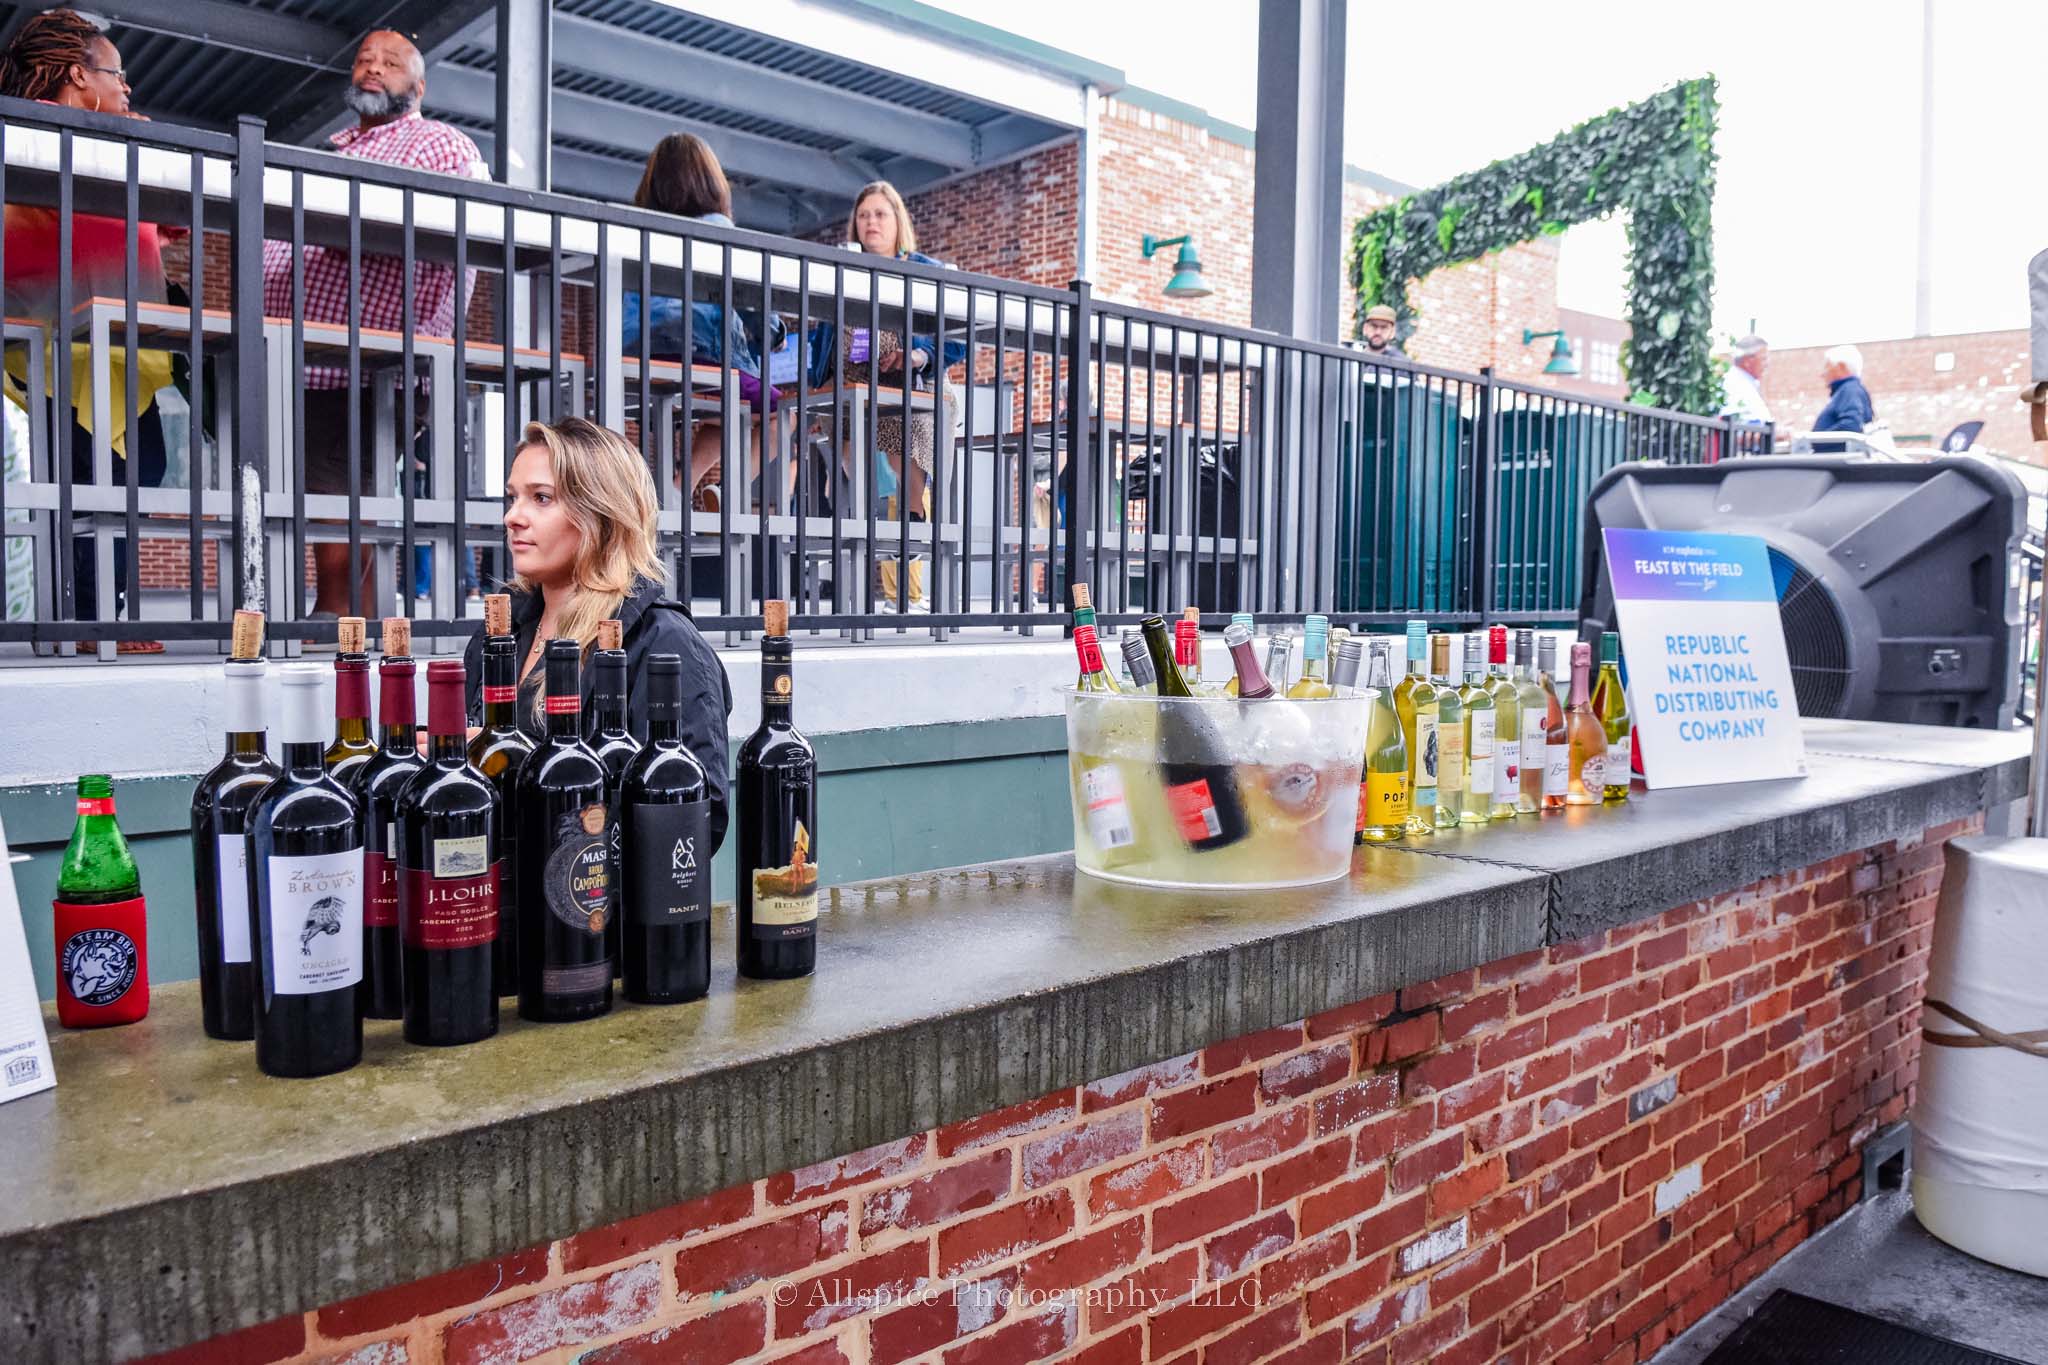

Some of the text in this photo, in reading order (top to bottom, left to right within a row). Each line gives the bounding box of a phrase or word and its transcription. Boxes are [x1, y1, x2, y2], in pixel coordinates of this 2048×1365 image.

[1634, 560, 1743, 576] FEAST BY THE FIELD
[1666, 635, 1749, 654] REPUBLIC
[1667, 662, 1758, 682] NATIONAL
[1655, 690, 1778, 712] DISTRIBUTING
[1679, 718, 1765, 740] COMPANY
[582, 850, 607, 864] MASI
[288, 874, 356, 893] BROWN
[668, 904, 700, 914] BANFI
[64, 932, 136, 972] HOME TEAM BBQ
